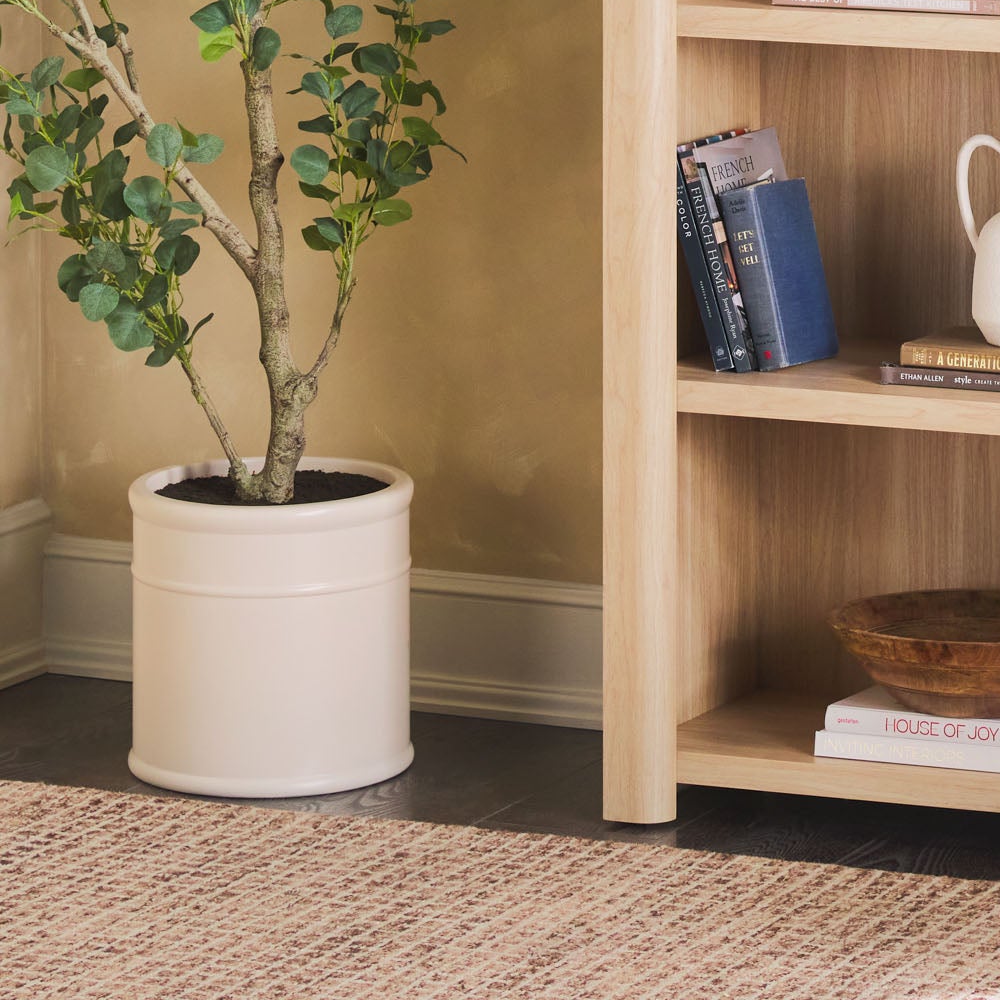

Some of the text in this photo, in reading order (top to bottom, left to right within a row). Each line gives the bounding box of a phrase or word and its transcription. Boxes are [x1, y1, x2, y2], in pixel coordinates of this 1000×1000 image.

[711, 156, 754, 182] FRENCH
[677, 199, 692, 238] COLOR
[691, 186, 727, 293] FRENCH HOME
[937, 351, 944, 366] A
[900, 372, 923, 381] ETHAN
[924, 374, 945, 383] ALLEN
[954, 375, 972, 385] style
[885, 717, 1000, 742] HOUSE OF JOY
